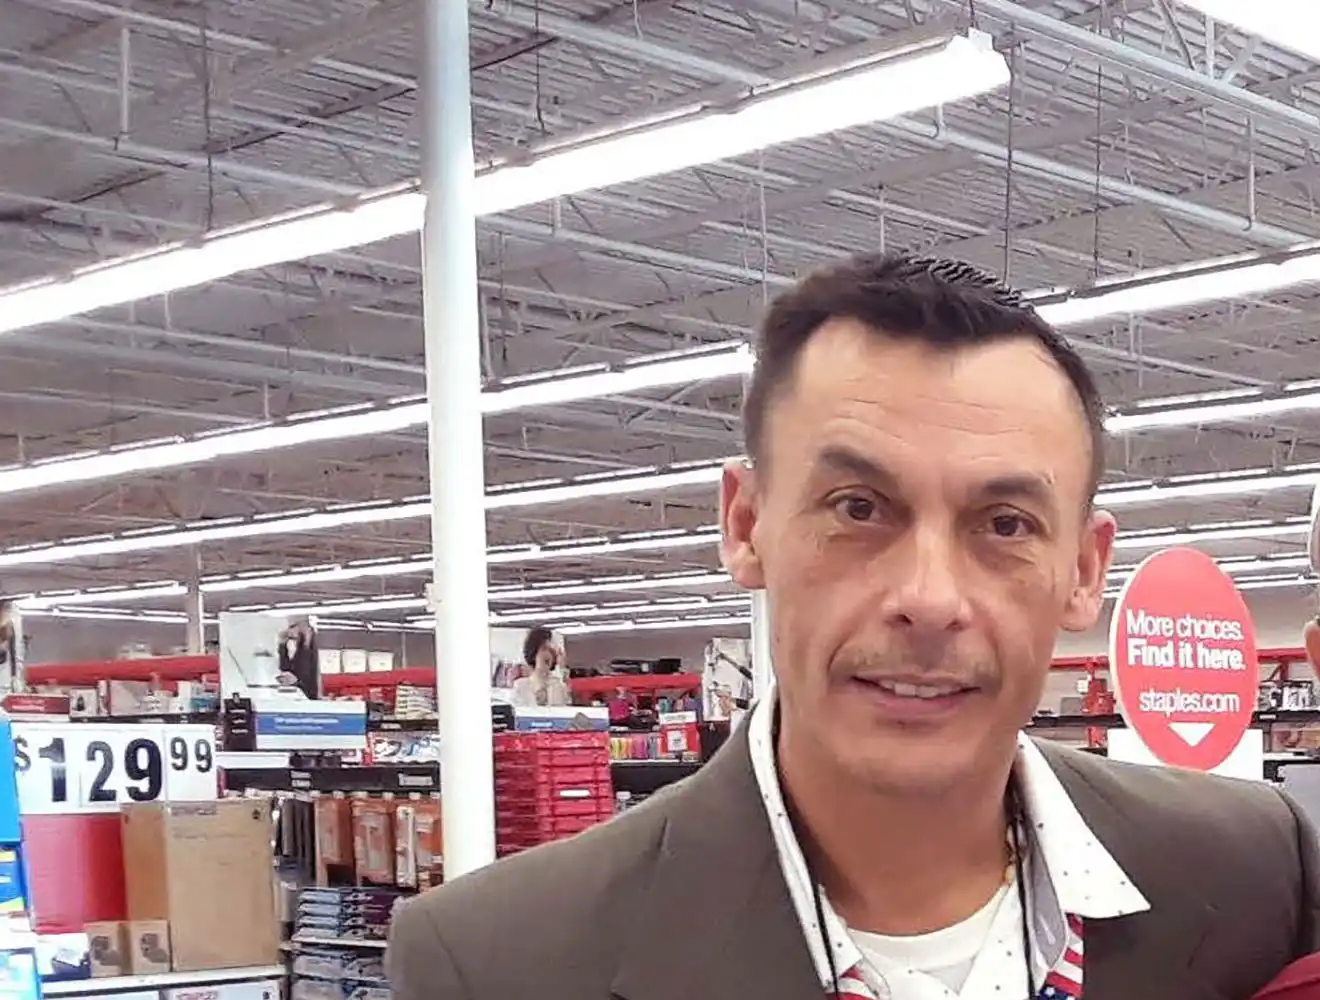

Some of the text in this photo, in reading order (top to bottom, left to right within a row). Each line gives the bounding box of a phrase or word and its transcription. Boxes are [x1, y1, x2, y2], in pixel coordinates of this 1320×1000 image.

[1126, 609, 1244, 641] More choices.
[1128, 638, 1247, 671] Find it here.
[1139, 688, 1241, 717] staples.com
